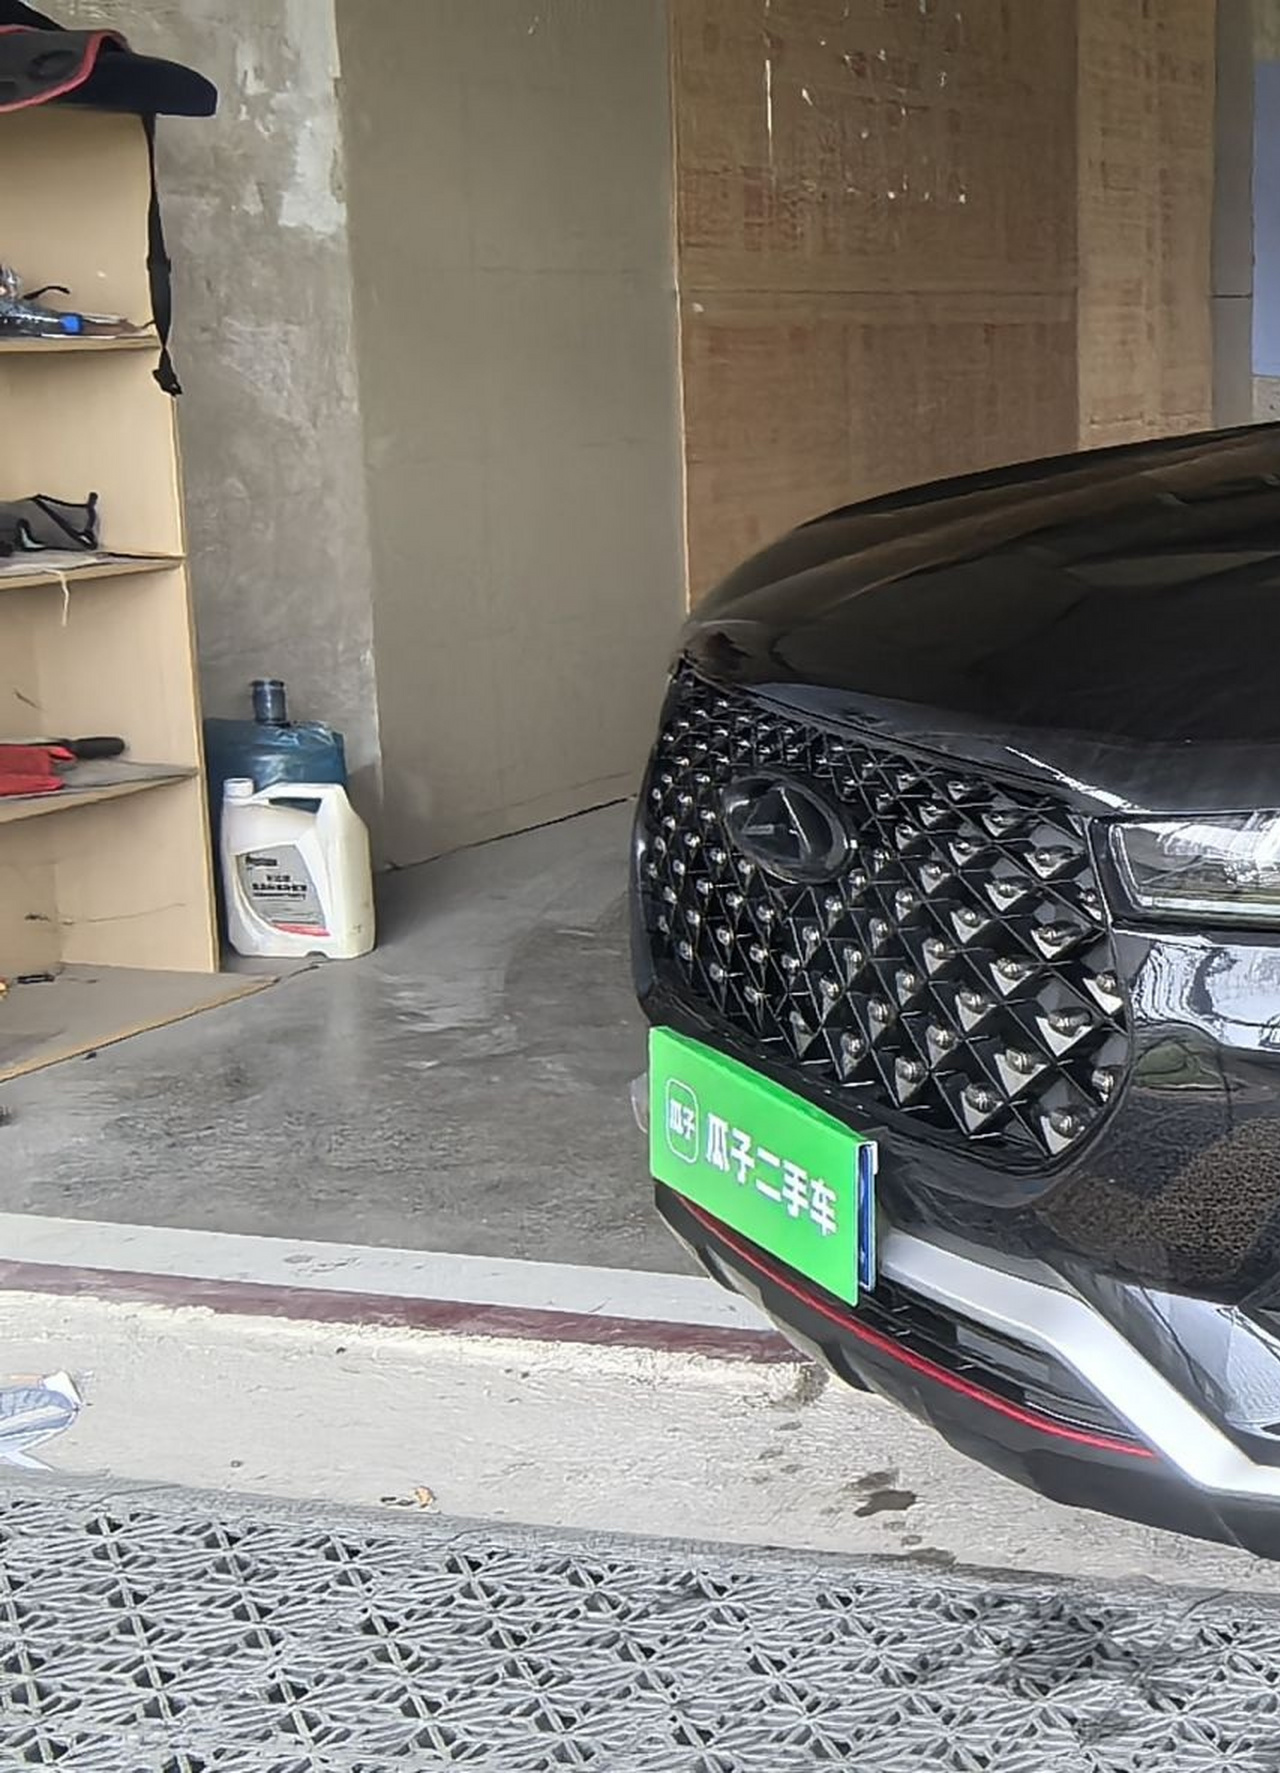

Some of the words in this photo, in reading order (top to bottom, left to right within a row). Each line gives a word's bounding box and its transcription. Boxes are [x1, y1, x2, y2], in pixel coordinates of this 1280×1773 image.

[669, 1097, 696, 1141] 瓜子
[705, 1111, 838, 1237] 瓜子二手车
